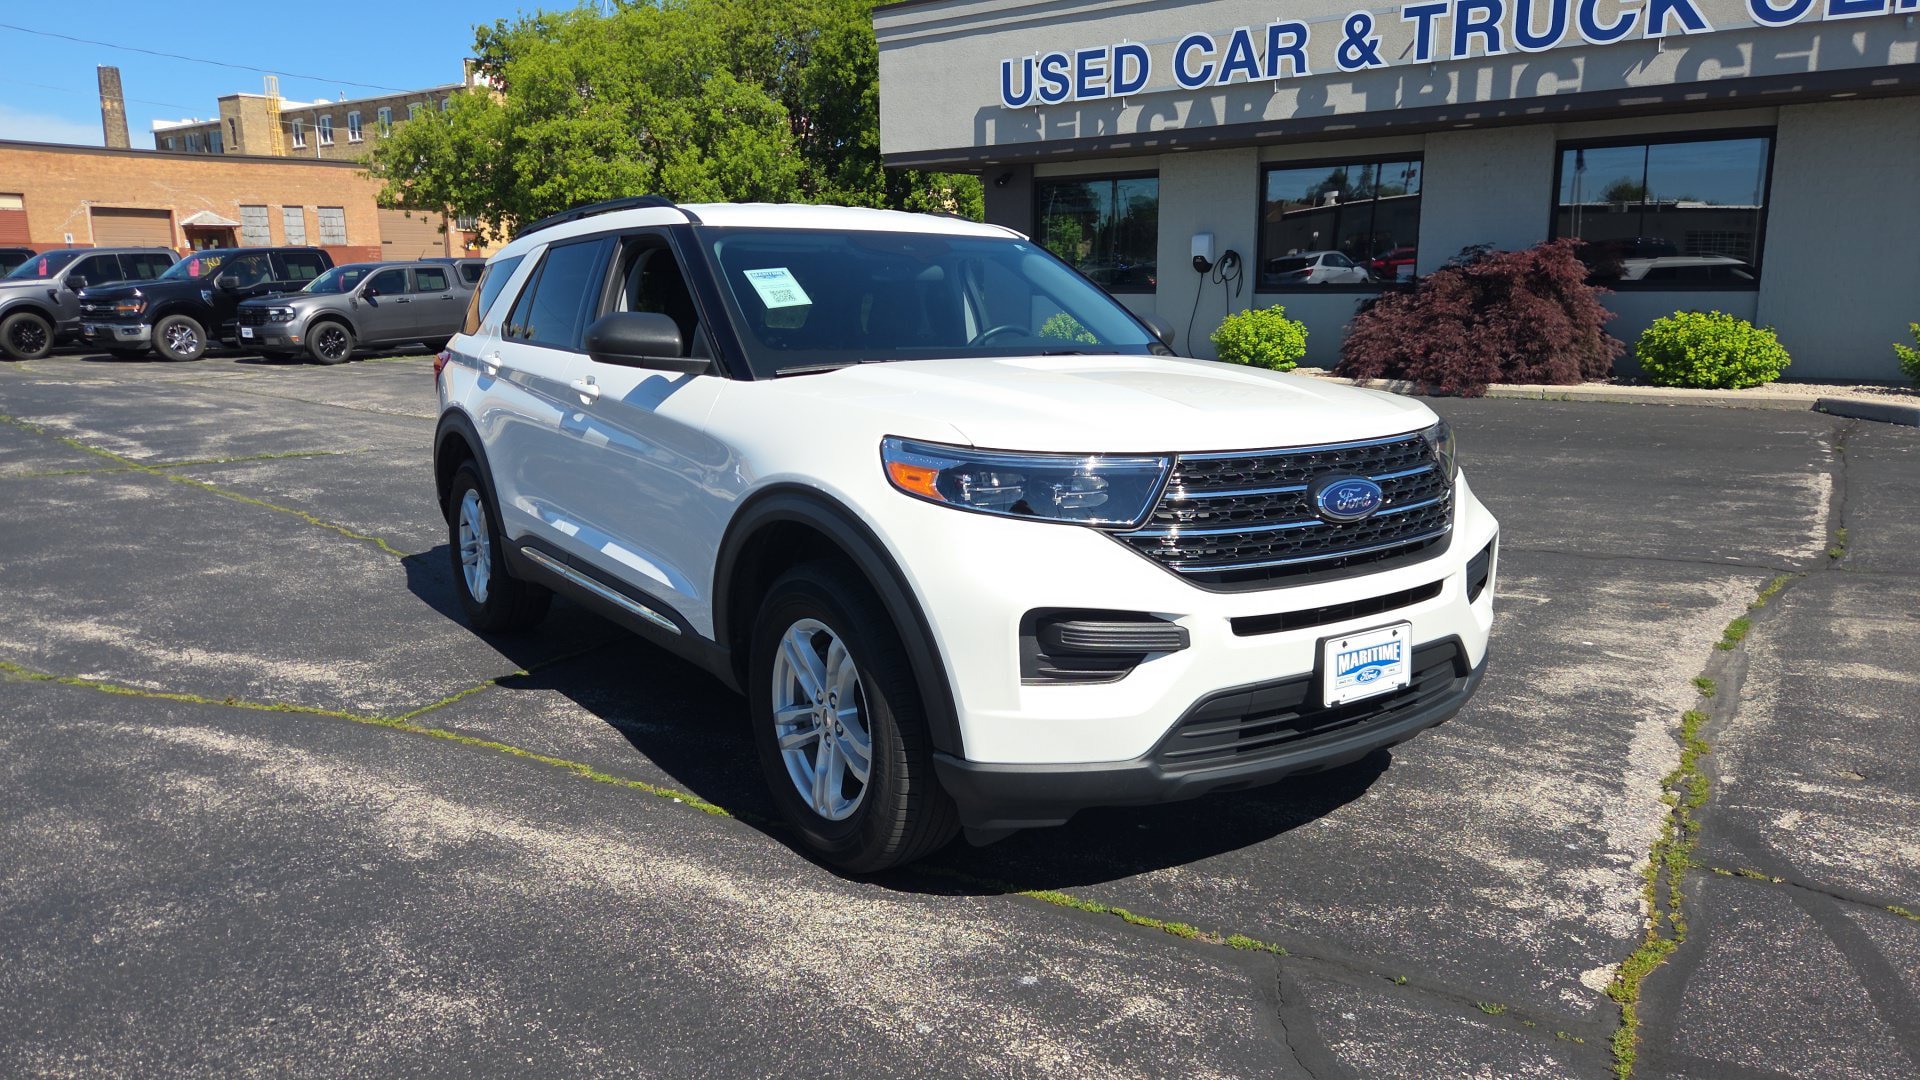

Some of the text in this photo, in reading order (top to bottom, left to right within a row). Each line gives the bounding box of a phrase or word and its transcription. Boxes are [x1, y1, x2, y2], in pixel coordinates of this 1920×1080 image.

[1000, 42, 1152, 109] USED
[1172, 20, 1312, 90] CAR
[1336, 10, 1389, 72] &
[1400, 0, 1715, 64] TRUCK
[1337, 487, 1371, 510] Ford
[1338, 641, 1401, 675] MARITIME
[1359, 668, 1380, 682] Ford
